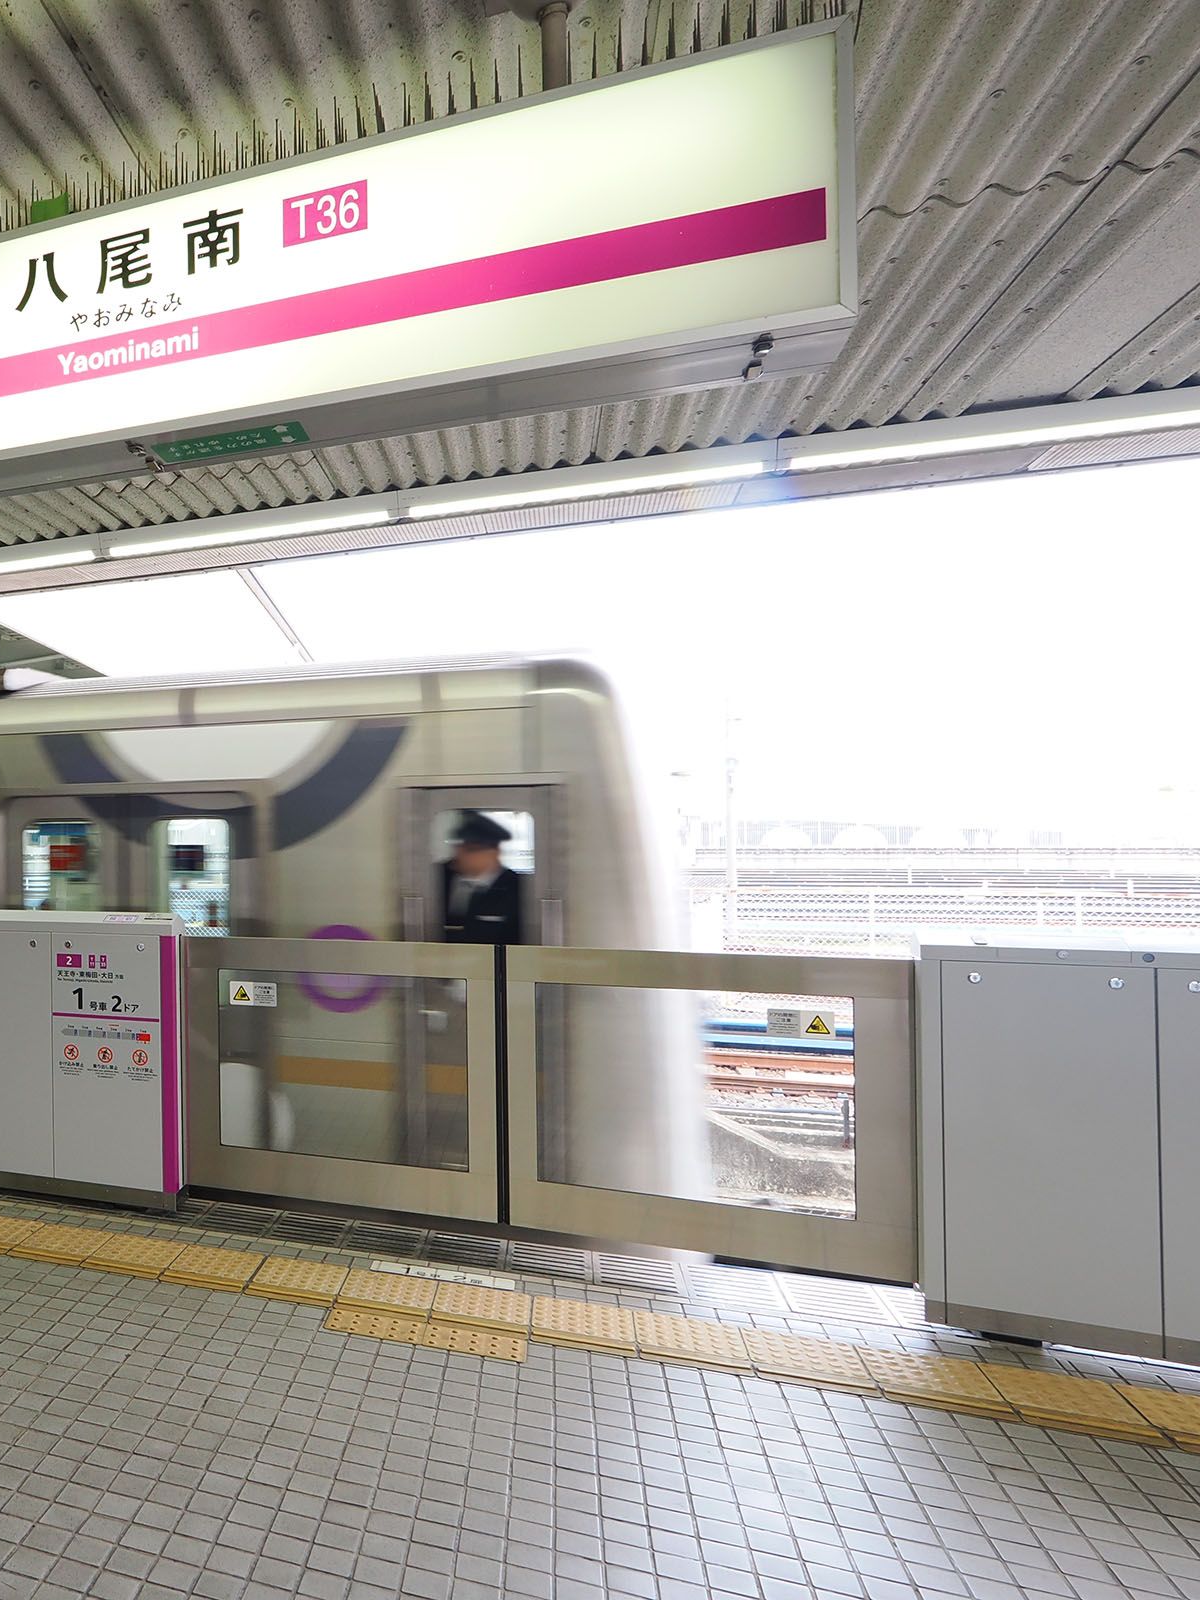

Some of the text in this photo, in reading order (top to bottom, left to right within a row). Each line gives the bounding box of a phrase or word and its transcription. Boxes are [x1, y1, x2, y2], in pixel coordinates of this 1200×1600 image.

[290, 188, 360, 239] T36
[16, 208, 243, 312] 八尾南
[70, 293, 182, 332] やおみなみ
[57, 326, 200, 376] Yaominami
[66, 956, 73, 966] 2
